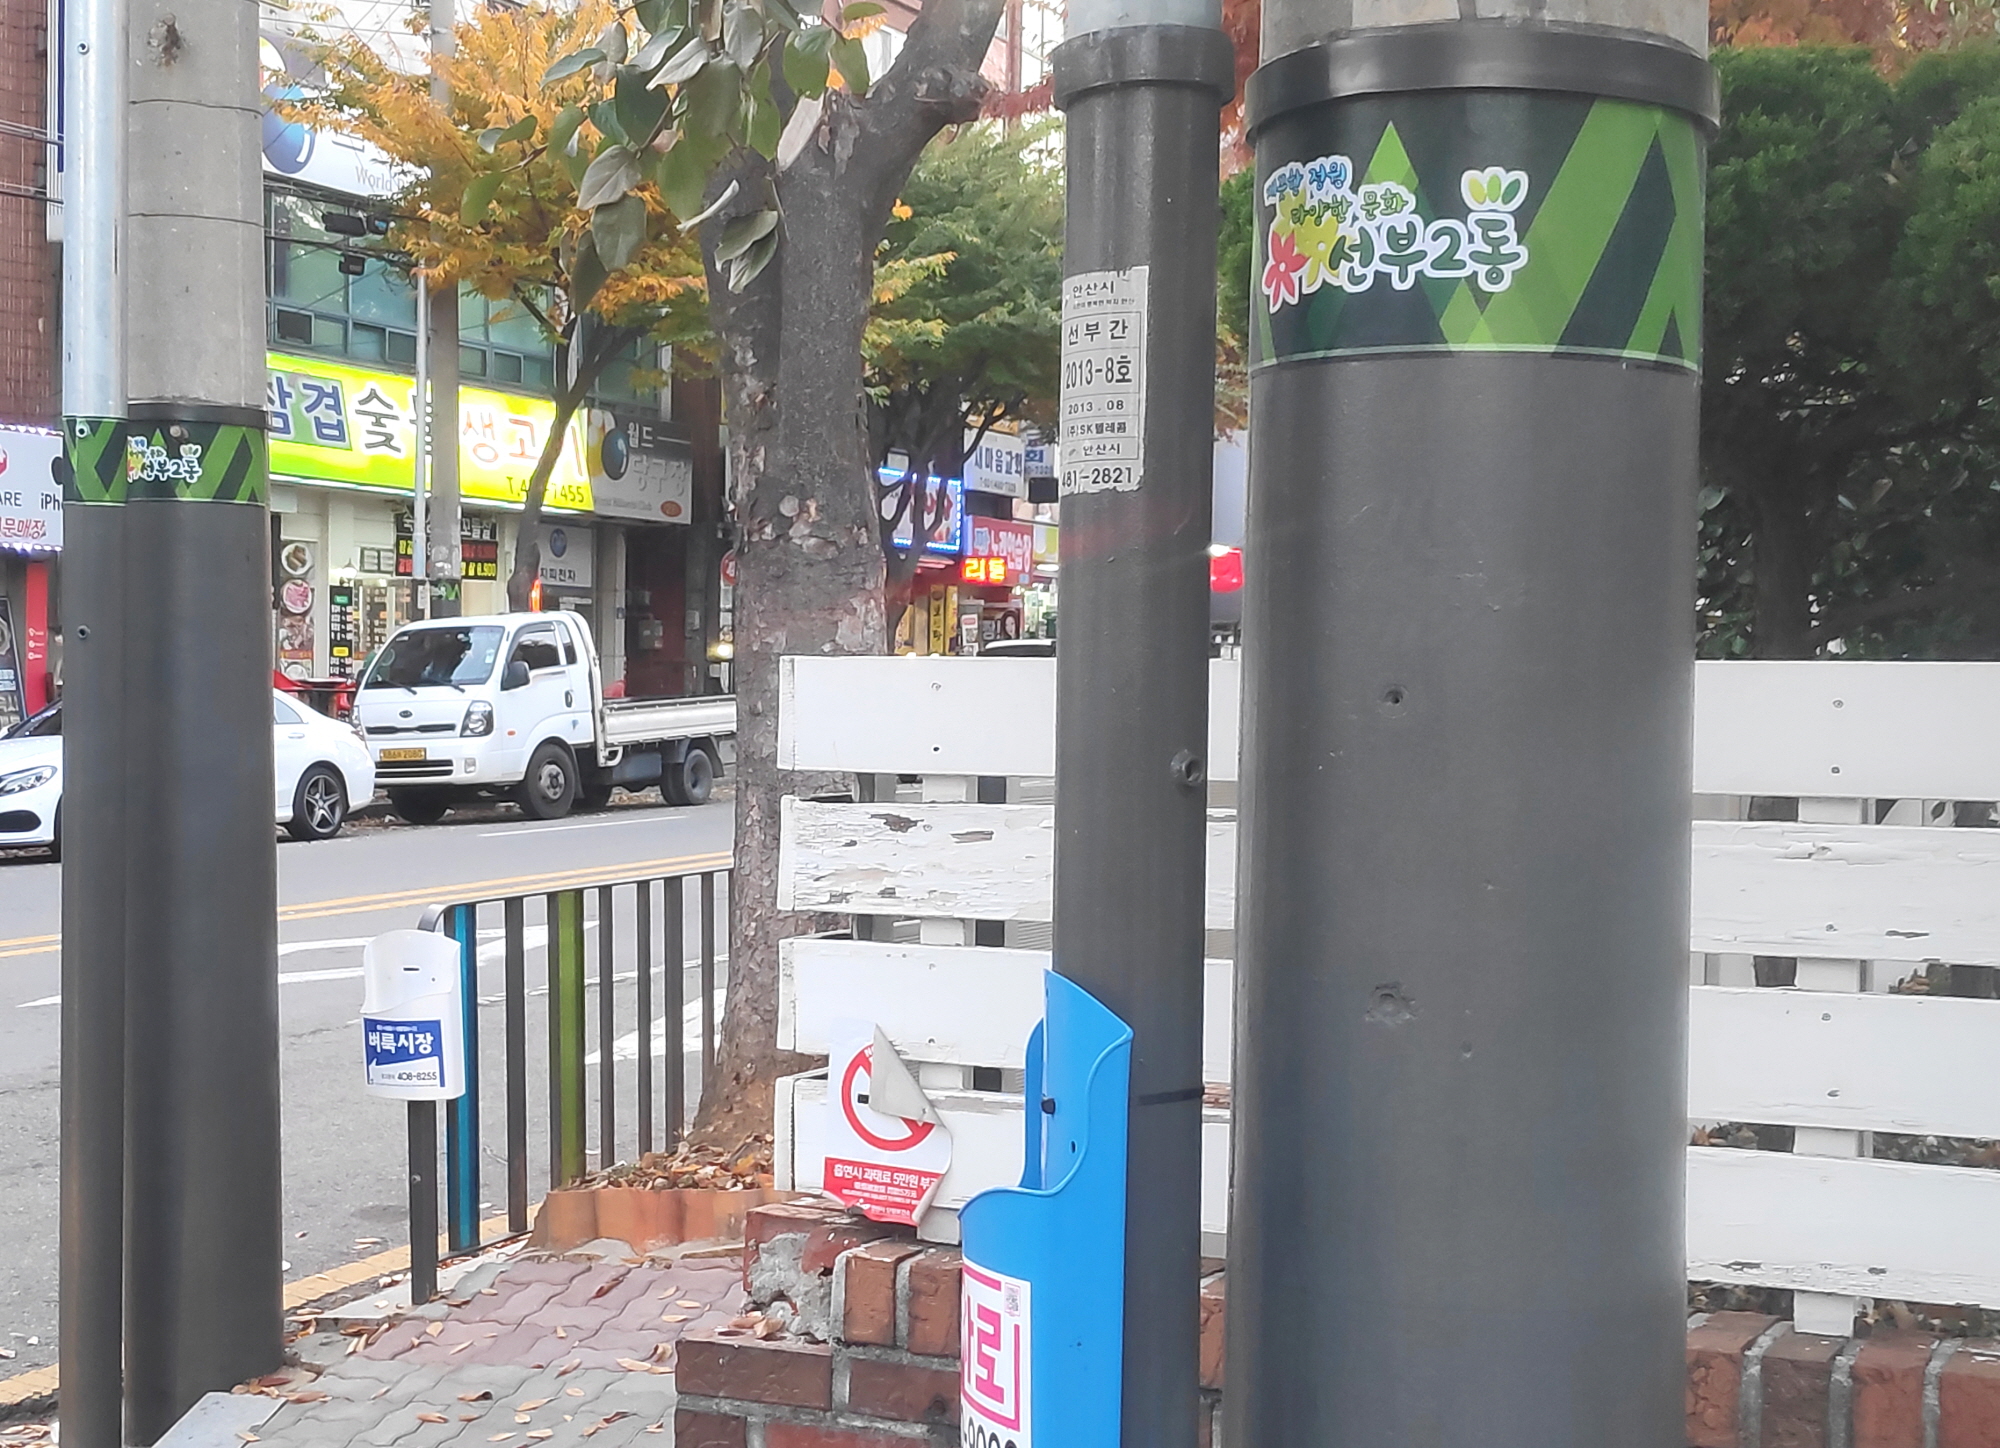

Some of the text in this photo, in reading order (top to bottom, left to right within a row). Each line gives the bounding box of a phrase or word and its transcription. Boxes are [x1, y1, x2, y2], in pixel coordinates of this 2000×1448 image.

[355, 165, 392, 192] World
[1308, 161, 1347, 191] 정원
[1360, 187, 1409, 220] 문화
[1328, 218, 1522, 286] 선부2동
[1073, 280, 1114, 299] 안산시
[1065, 355, 1133, 390] 2013-8호
[627, 421, 654, 448] 월드
[1082, 442, 1121, 457] 안산시
[141, 458, 200, 481] 선부2동
[633, 454, 688, 497] 당구장
[1062, 466, 1132, 488] 481-2821
[0, 517, 46, 540] 문매장
[368, 1031, 434, 1055] 벼룩시장
[834, 1164, 862, 1180] 흡연시
[863, 1167, 891, 1184] 과태료
[893, 1172, 919, 1189] 5만원
